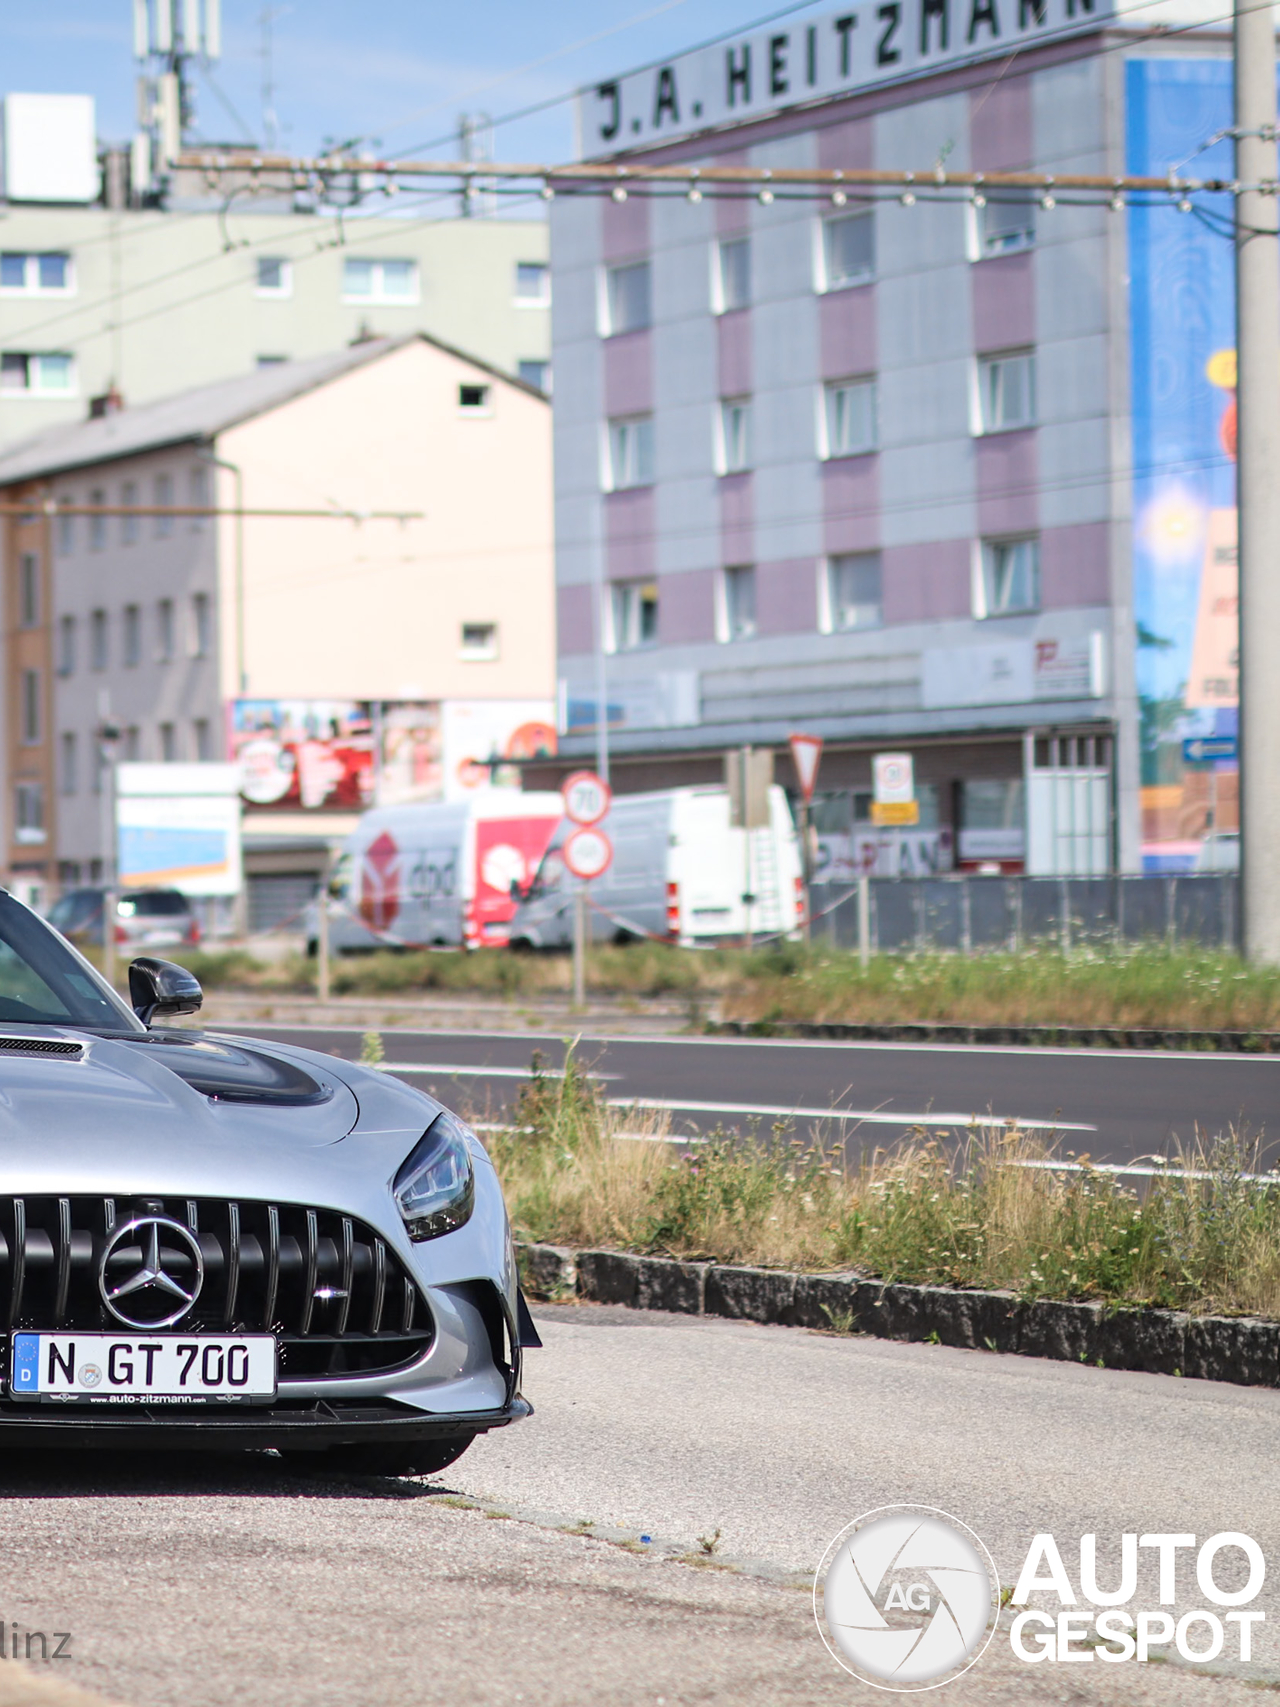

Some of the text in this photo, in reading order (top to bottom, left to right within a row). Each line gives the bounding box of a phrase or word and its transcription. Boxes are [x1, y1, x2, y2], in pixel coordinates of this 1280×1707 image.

[598, 66, 702, 141] J.A.
[20, 1369, 32, 1382] D
[48, 1342, 249, 1386] N GT 700
[90, 1394, 207, 1404] www.auto-zitzmann.com
